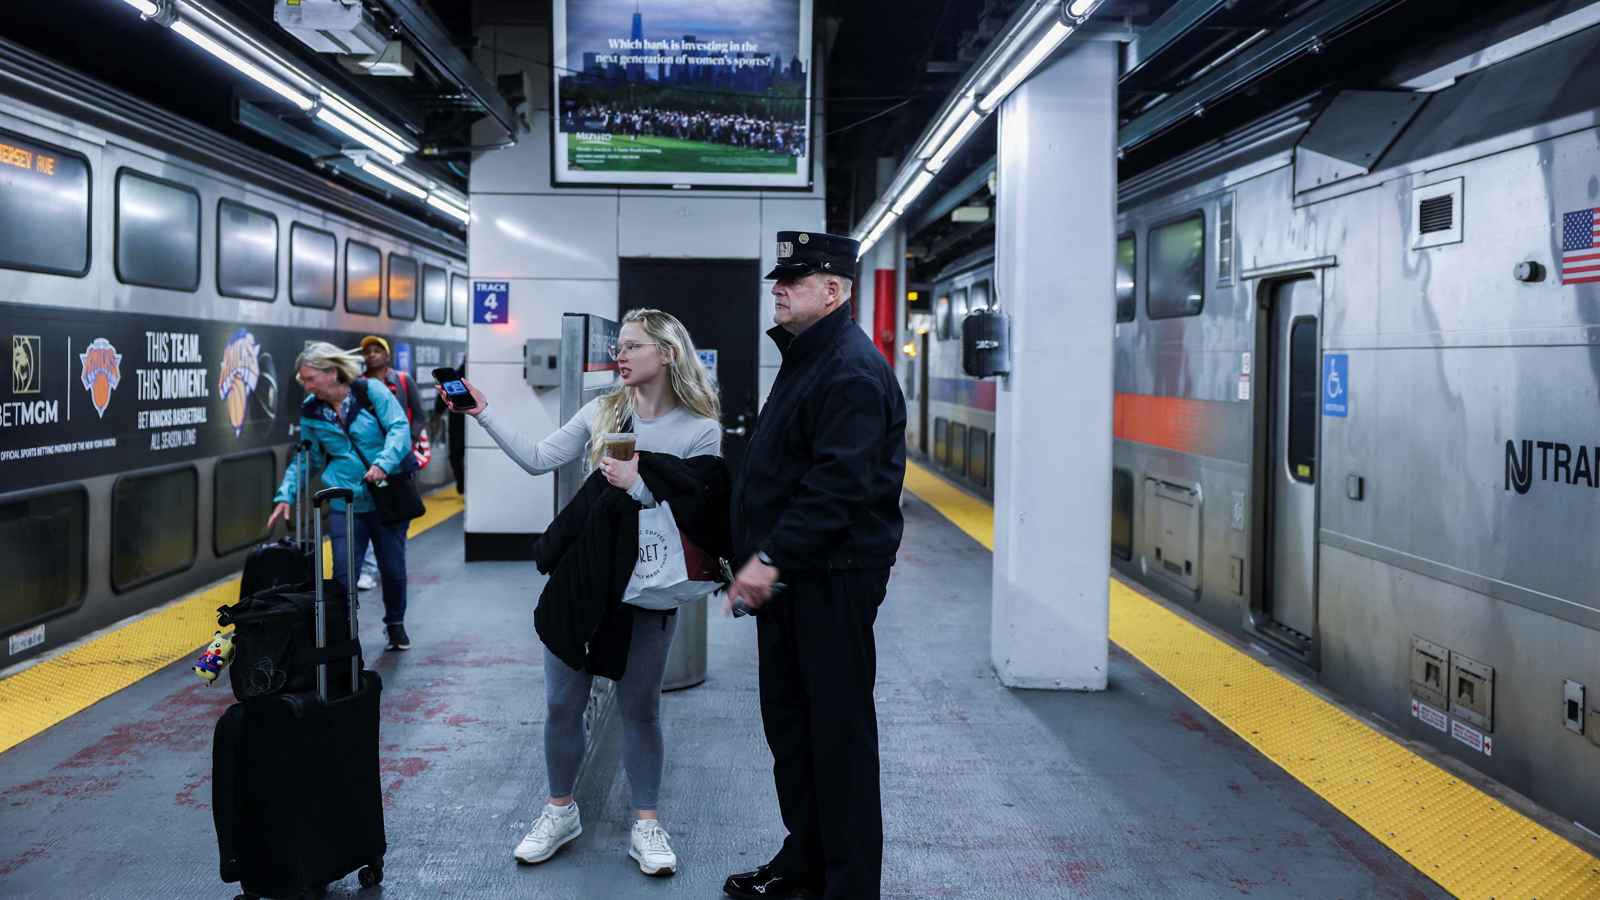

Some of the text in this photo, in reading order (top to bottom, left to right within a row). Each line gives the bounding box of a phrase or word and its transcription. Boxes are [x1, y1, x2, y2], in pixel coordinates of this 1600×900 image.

[608, 39, 759, 53] Which bank is investing in the
[595, 54, 770, 68] next generation of women's sports?
[476, 283, 507, 293] TRACK
[484, 293, 499, 310] 4
[145, 331, 203, 363] THIS TEAM.
[136, 368, 209, 400] THIS MOMENT.
[138, 407, 208, 430] BET KNICKS BASKETBALL
[151, 432, 161, 451] ALL
[0, 450, 20, 462] OFFICIAL
